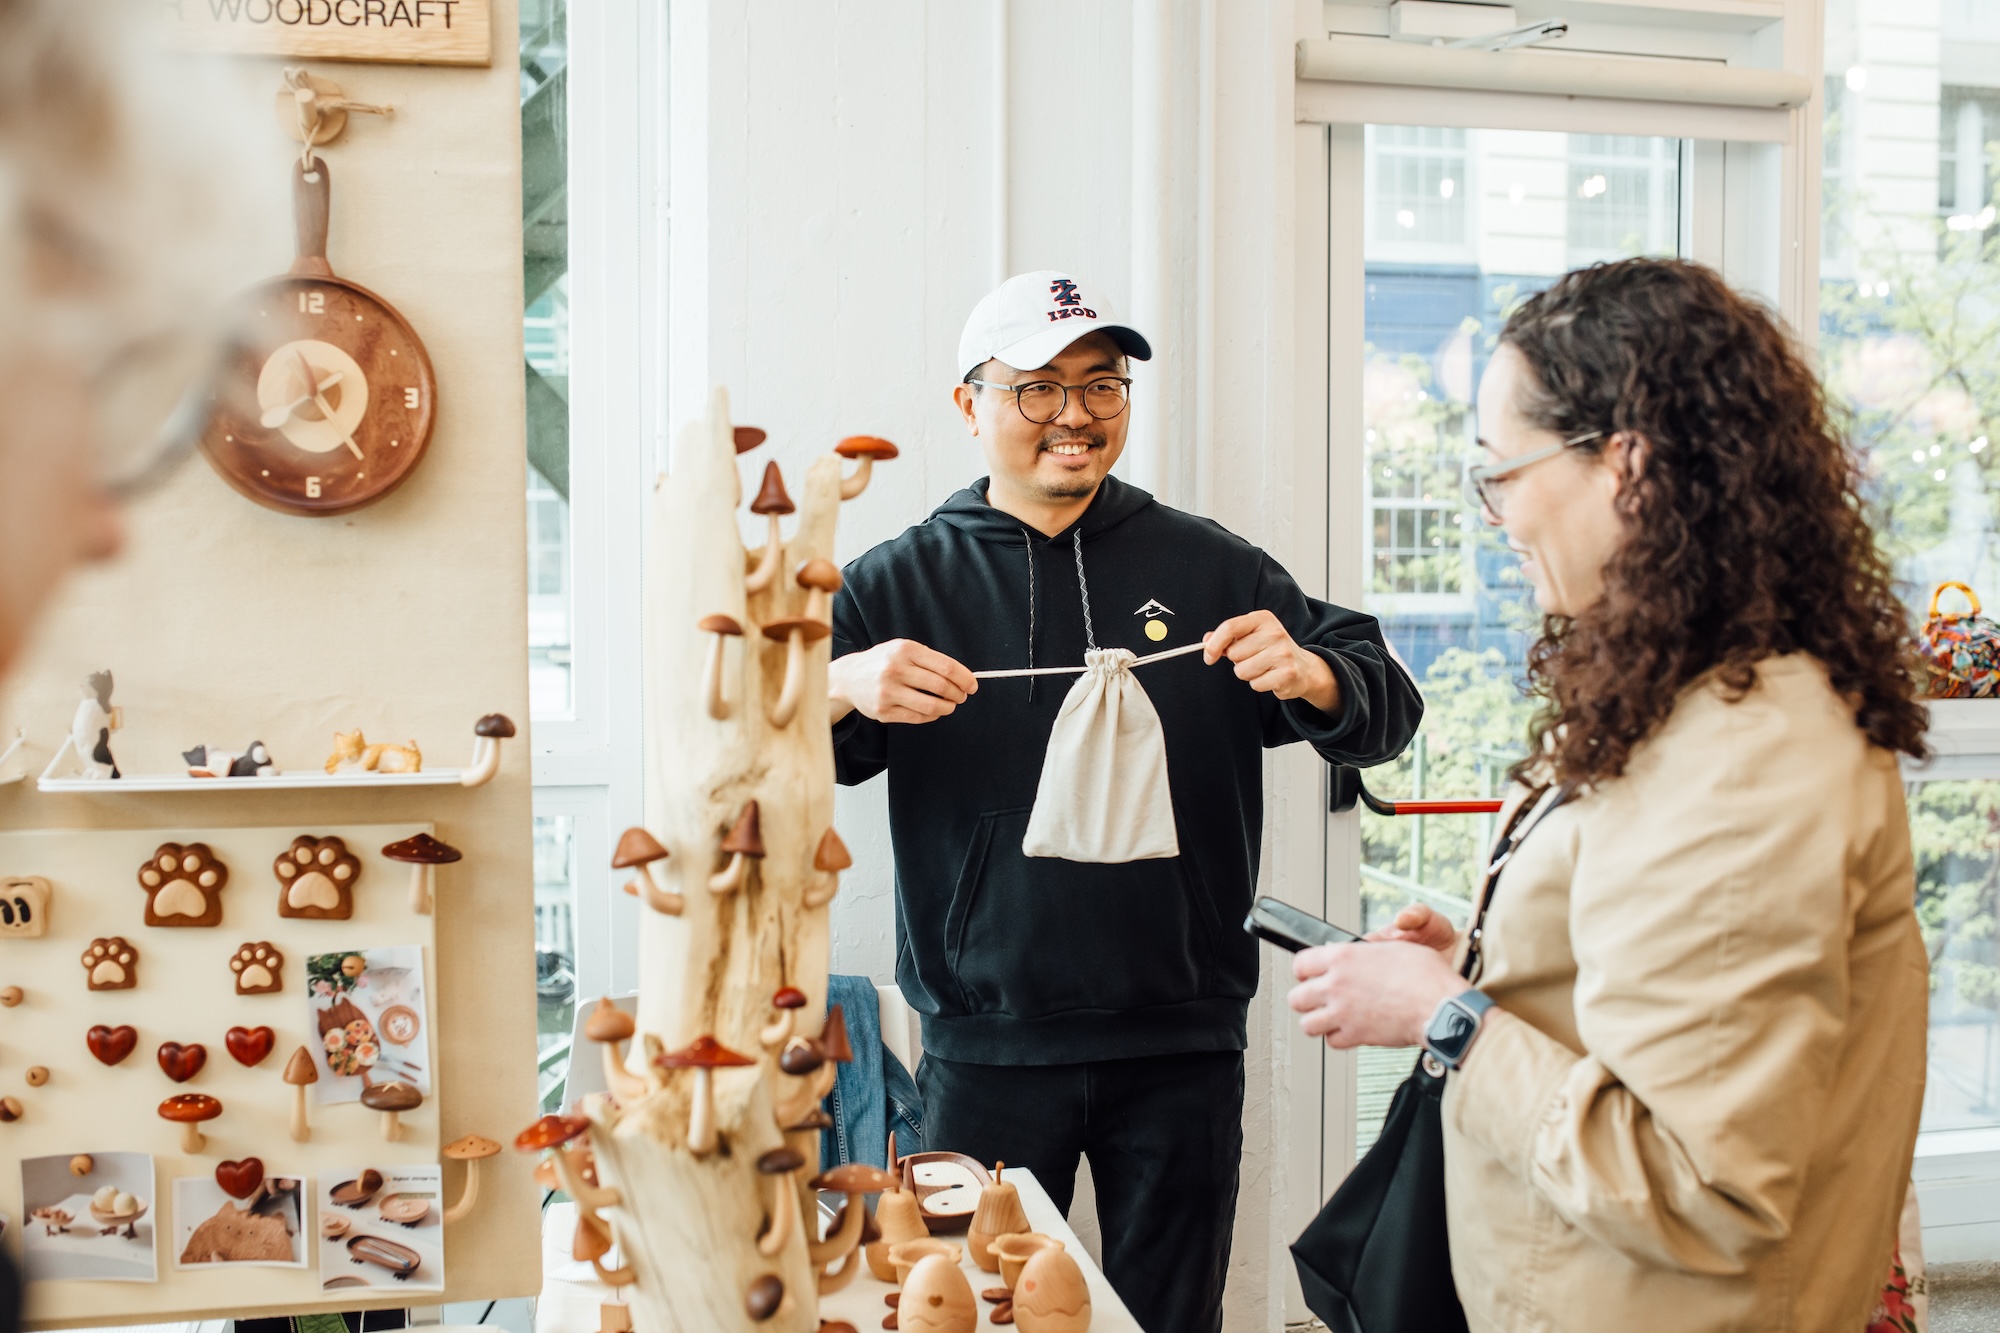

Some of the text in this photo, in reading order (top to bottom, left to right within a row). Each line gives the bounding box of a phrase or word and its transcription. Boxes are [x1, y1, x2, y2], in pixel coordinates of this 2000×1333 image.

[208, 0, 460, 29] WOODCRAFT
[299, 292, 325, 314] 12
[1047, 307, 1097, 321] IZOD
[404, 387, 419, 409] 3
[305, 476, 321, 498] 6
